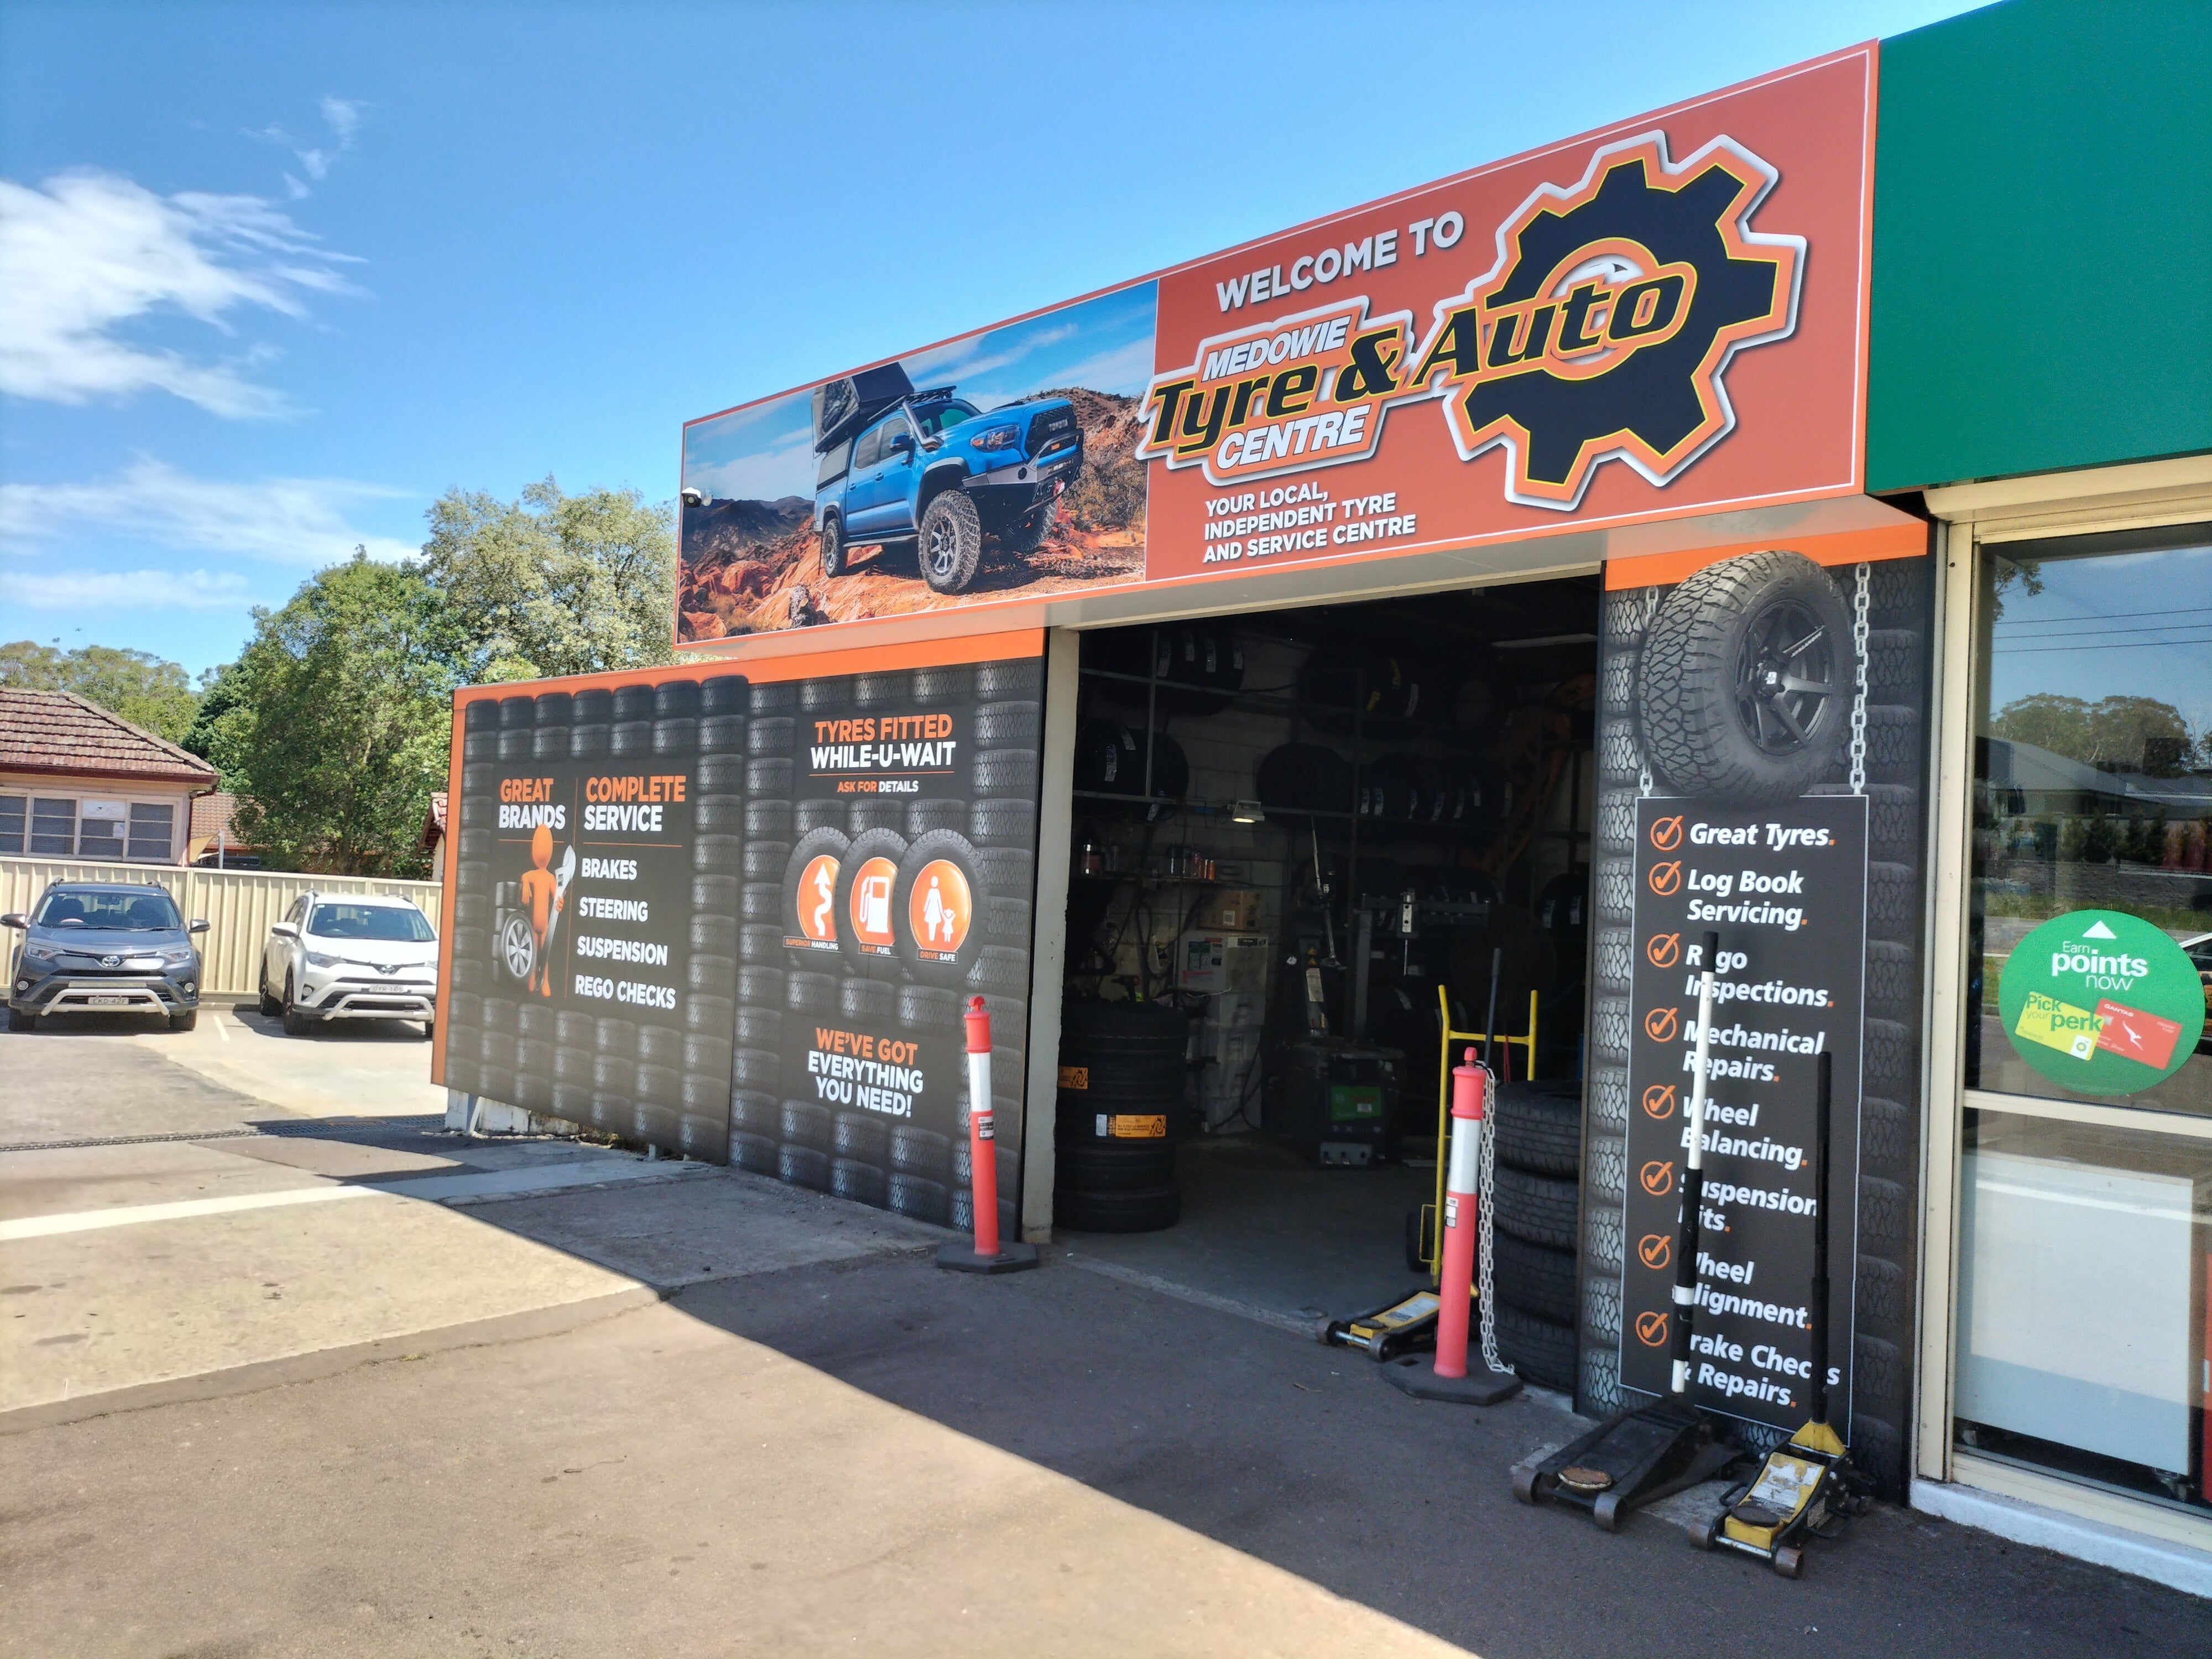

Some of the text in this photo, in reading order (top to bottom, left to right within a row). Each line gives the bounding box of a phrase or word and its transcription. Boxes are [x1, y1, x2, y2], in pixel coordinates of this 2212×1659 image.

[1216, 211, 1464, 312] WELCOME TO
[1202, 314, 1353, 383] MEDOWIE
[1151, 273, 1686, 456] Tyre & Auto
[1216, 404, 1371, 470] CENTRE
[1206, 481, 1328, 518] YOUR LOCAL,
[1204, 492, 1396, 540] INDEPENDENT TYRE
[1203, 514, 1416, 563] AND SERVICE CENTRE
[815, 714, 953, 744] TYRES FITTED
[810, 741, 957, 769] WHILE-U-WAIT
[500, 778, 554, 802] GREAT
[586, 775, 686, 802] COMPLETE
[837, 780, 919, 793] ASK FOR DETAILS
[499, 805, 566, 830] BRANDS
[583, 805, 663, 831] SERVICE
[1689, 823, 1836, 851] Great Tyres.
[581, 857, 638, 880] BRAKES
[1687, 869, 1804, 897] Log Book
[578, 896, 649, 922] STEERING
[1687, 899, 1808, 931] Servicing.
[577, 936, 668, 966] SUSPENSION
[785, 938, 839, 951] SUPERIOR HANDLING
[862, 945, 891, 954] SAVE FUEL
[920, 951, 956, 962] DRIVE SAFE
[2063, 941, 2090, 954] Earn
[1686, 945, 1747, 974] Rgo
[2051, 949, 2148, 977] points
[575, 974, 676, 1010] REGO CHECKS
[2086, 975, 2134, 992] now
[2026, 995, 2063, 1012] Pick
[2104, 1003, 2135, 1017] QANTAS
[2026, 1010, 2103, 1032] your perk
[815, 1027, 919, 1066] WE'VE GOT
[1683, 1020, 1825, 1055] Mechanical
[808, 1050, 924, 1094] EVERYTHING
[815, 1076, 912, 1118] YOU NEED!
[1681, 1126, 1808, 1171] Balancing.
[1678, 1173, 1817, 1217] spension
[1678, 1204, 1731, 1233] its.
[1695, 1251, 1755, 1285] heel
[1693, 1282, 1812, 1330] lignment.
[1690, 1333, 1841, 1385] rake Checs
[1698, 1362, 1797, 1408] Repairs.
